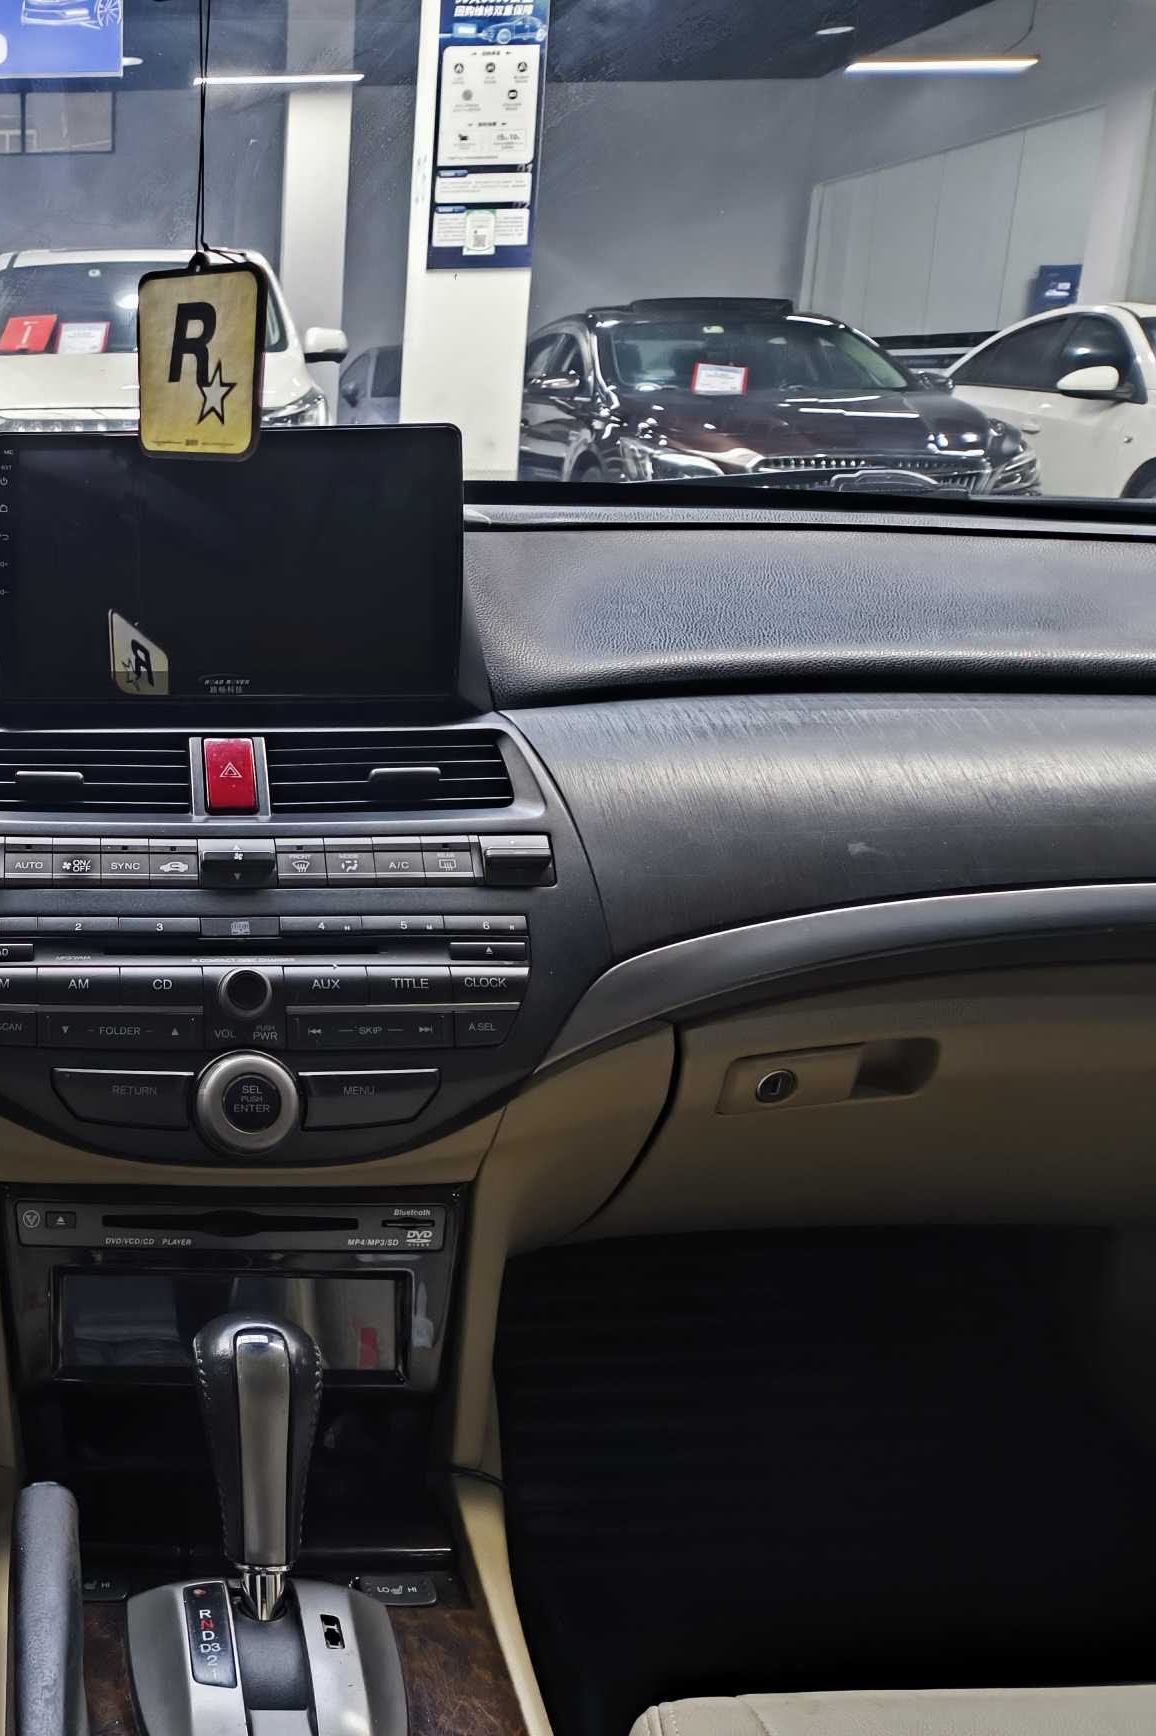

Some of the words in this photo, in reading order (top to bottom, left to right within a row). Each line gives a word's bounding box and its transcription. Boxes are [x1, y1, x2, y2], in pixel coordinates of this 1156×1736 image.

[14, 862, 44, 870] AUTO
[72, 865, 92, 873] OFF
[110, 862, 141, 870] SYNC
[388, 861, 410, 870] A/C
[74, 922, 83, 931] 2
[155, 922, 164, 932] 3
[317, 921, 325, 931] 4
[400, 920, 408, 930] 5
[482, 920, 490, 930] 6
[68, 979, 89, 990] AM
[152, 979, 173, 990] CD
[311, 978, 341, 990] AUX
[391, 977, 429, 989] TITLE
[464, 976, 508, 988] CLOCK
[99, 1026, 141, 1036] FOLDER
[214, 1029, 236, 1039] VOL
[358, 1026, 383, 1035] SKIP
[253, 1031, 278, 1041] PWR
[112, 1085, 157, 1096] RETURN
[241, 1085, 263, 1094] SEL
[344, 1086, 375, 1096] MENU
[241, 1095, 263, 1103] PUSH
[233, 1104, 271, 1113] ENTER
[406, 1230, 433, 1239] DVD
[162, 1238, 192, 1246] PLAYER
[199, 1609, 211, 1619] R
[200, 1619, 215, 1630] N
[202, 1630, 215, 1641] D
[200, 1642, 221, 1653] D3
[207, 1655, 218, 1666] 2
